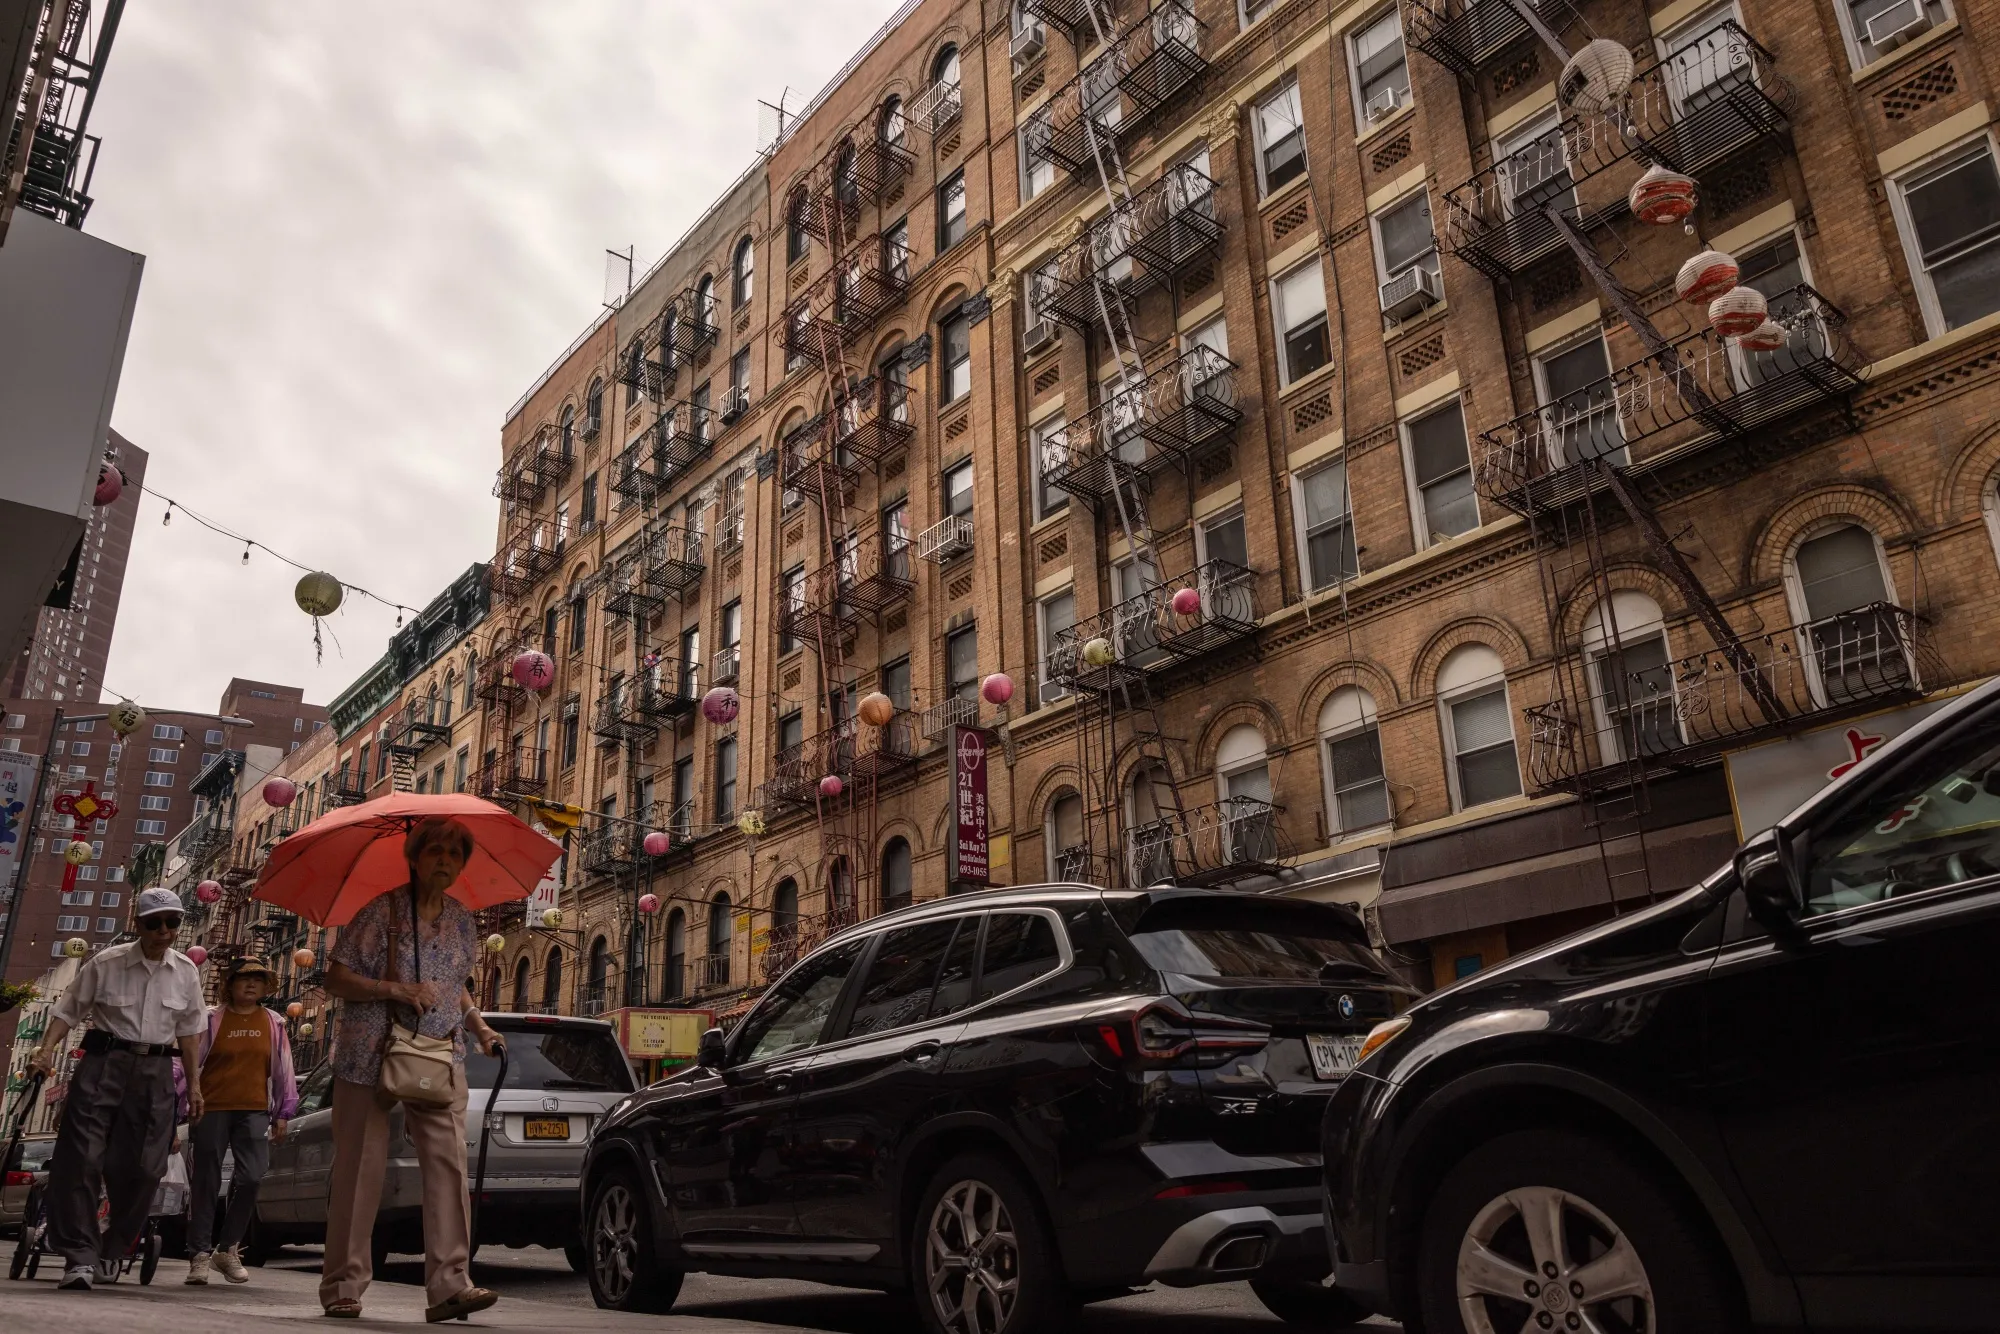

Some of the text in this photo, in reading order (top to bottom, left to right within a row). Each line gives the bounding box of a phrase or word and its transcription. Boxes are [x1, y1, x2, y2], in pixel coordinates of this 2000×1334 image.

[528, 655, 547, 679] 春
[720, 694, 738, 710] 和
[118, 707, 139, 727] 福
[70, 842, 83, 858] 春
[959, 864, 987, 877] 693-1055
[72, 939, 84, 952] 福
[1219, 1102, 1258, 1115] X3
